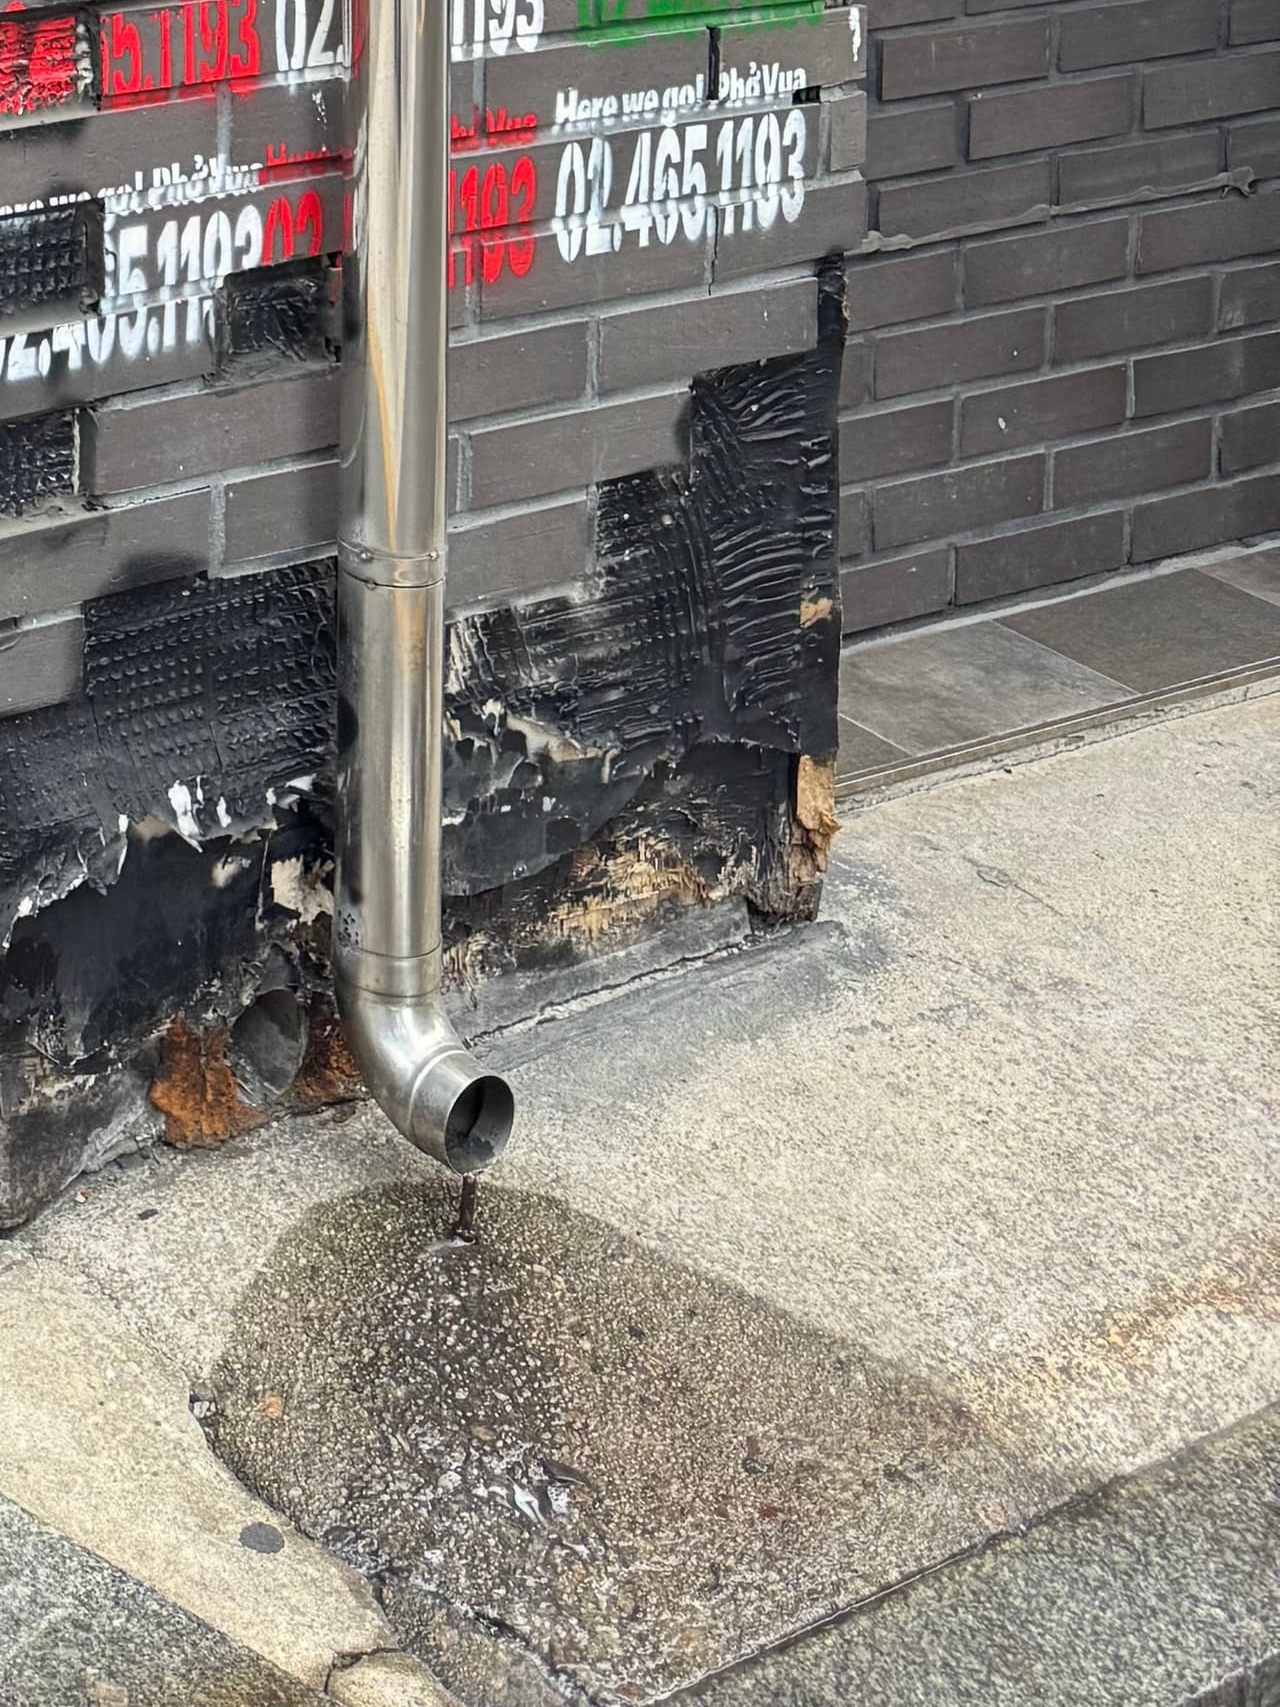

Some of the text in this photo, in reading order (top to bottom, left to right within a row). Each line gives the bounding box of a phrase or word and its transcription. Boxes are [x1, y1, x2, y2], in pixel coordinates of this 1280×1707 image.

[555, 87, 616, 131] Here
[623, 89, 655, 122] we
[662, 74, 705, 126] go!
[553, 109, 807, 263] 02.465.1193
